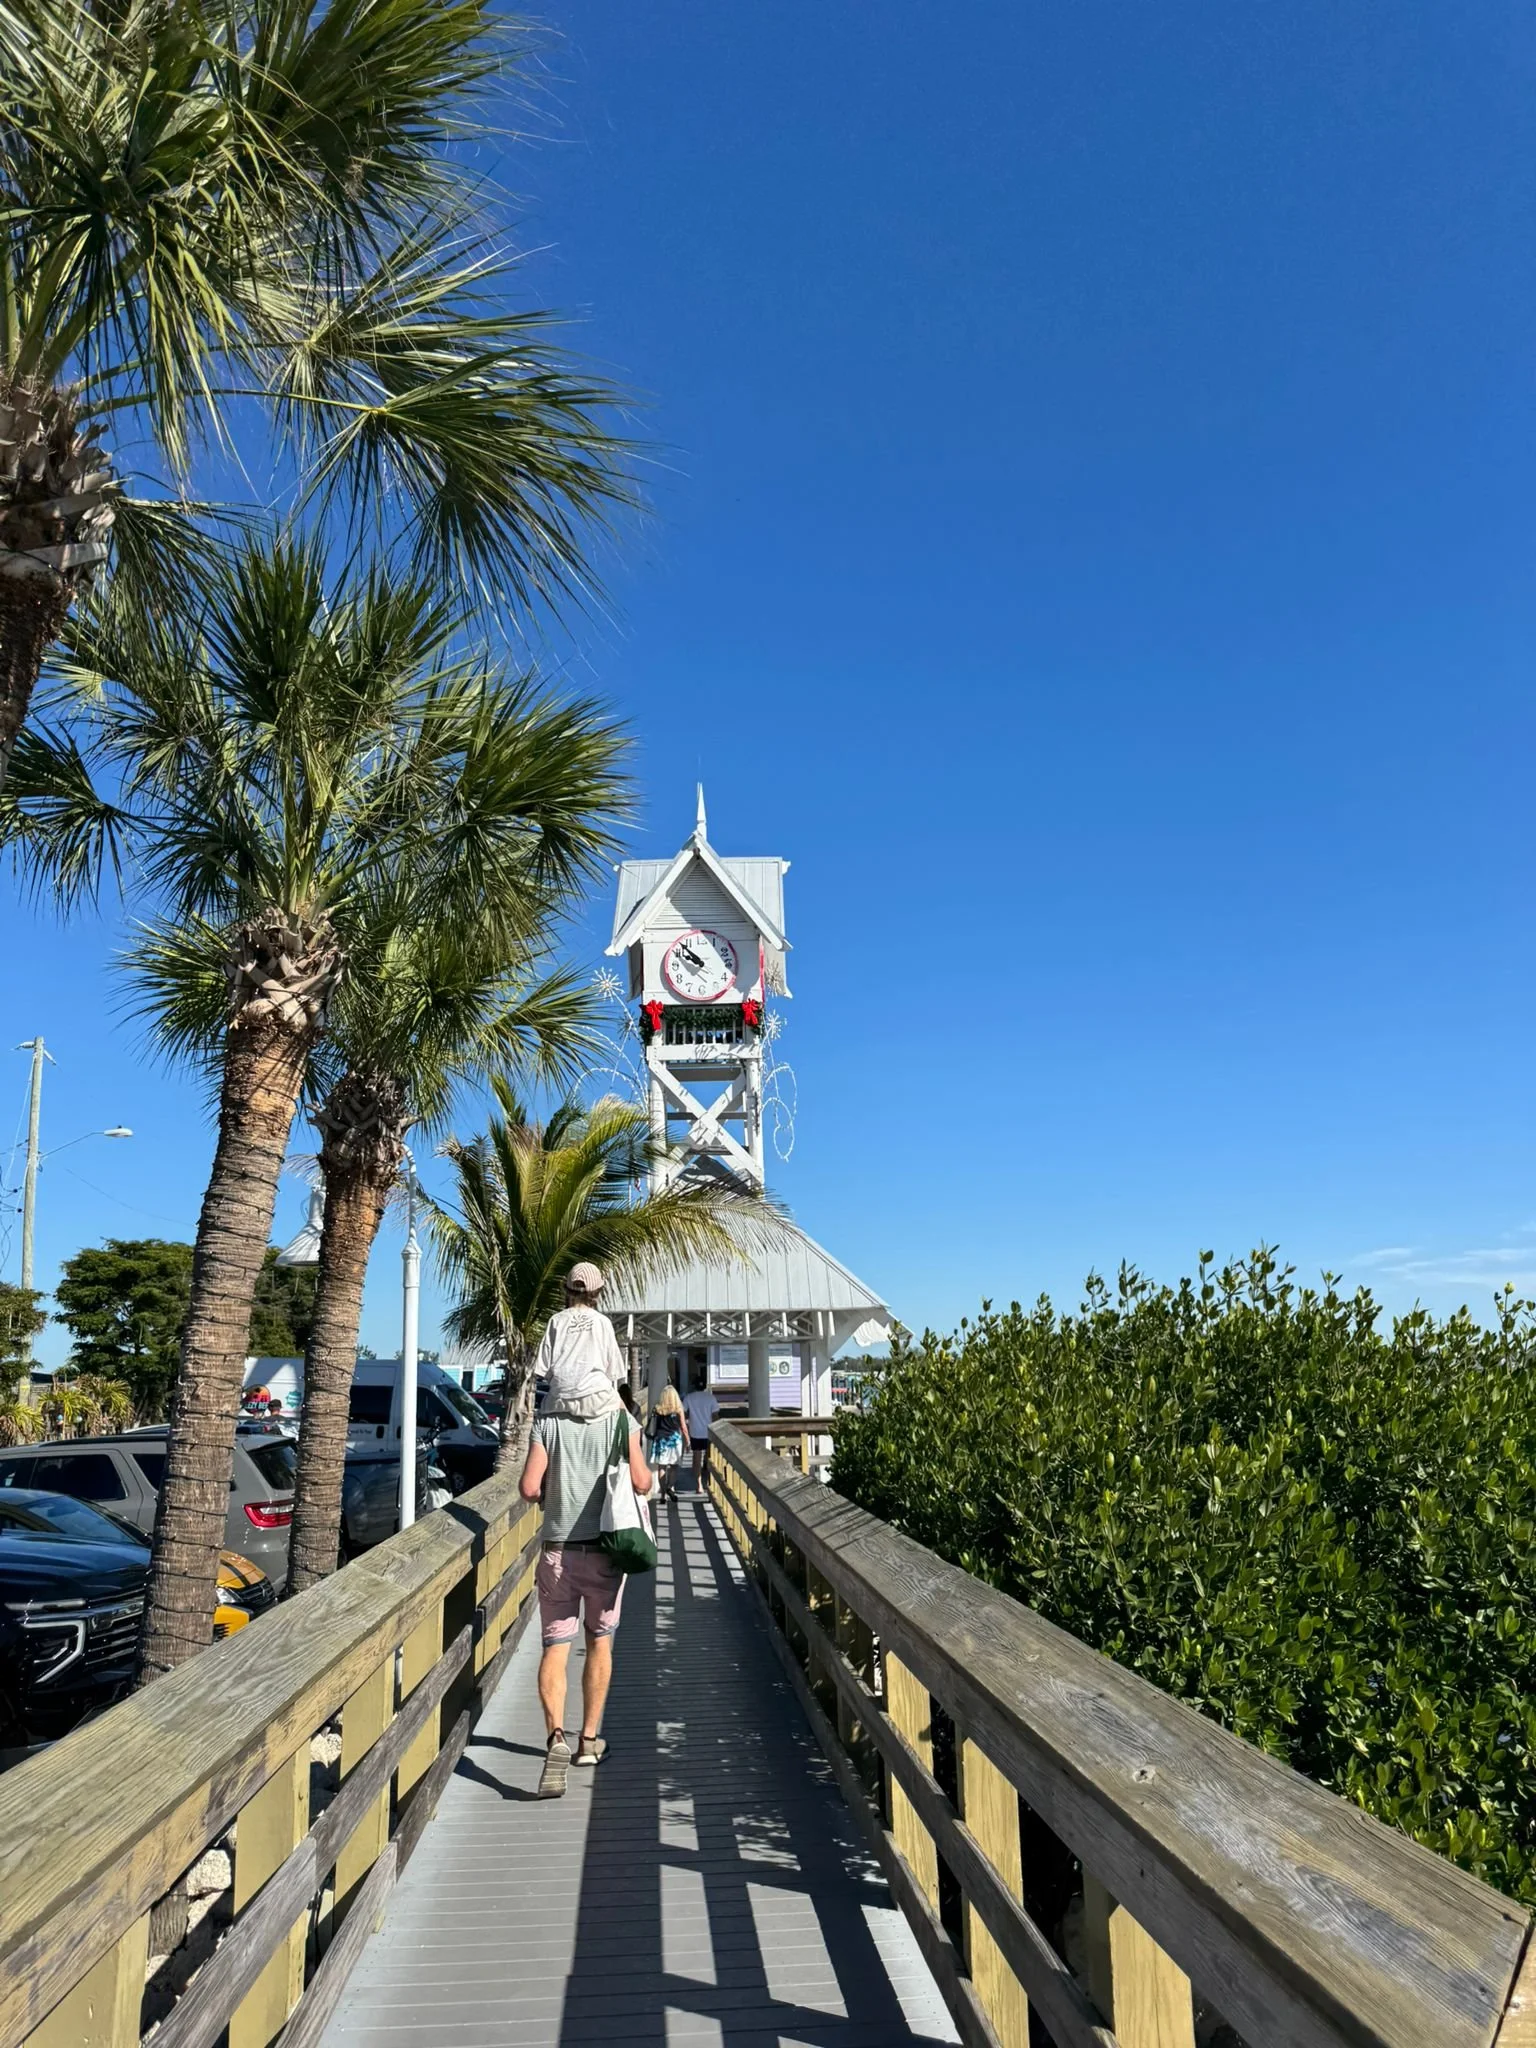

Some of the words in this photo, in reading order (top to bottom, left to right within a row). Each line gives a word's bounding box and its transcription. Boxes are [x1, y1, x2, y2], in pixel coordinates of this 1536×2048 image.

[712, 937, 716, 947] 1
[720, 947, 729, 957] 2
[672, 960, 680, 971] 9
[724, 958, 733, 969] 3
[676, 973, 683, 984] 8
[720, 972, 728, 982] 4
[685, 982, 693, 993] 7
[698, 985, 706, 996] 6
[712, 981, 719, 991] 5
